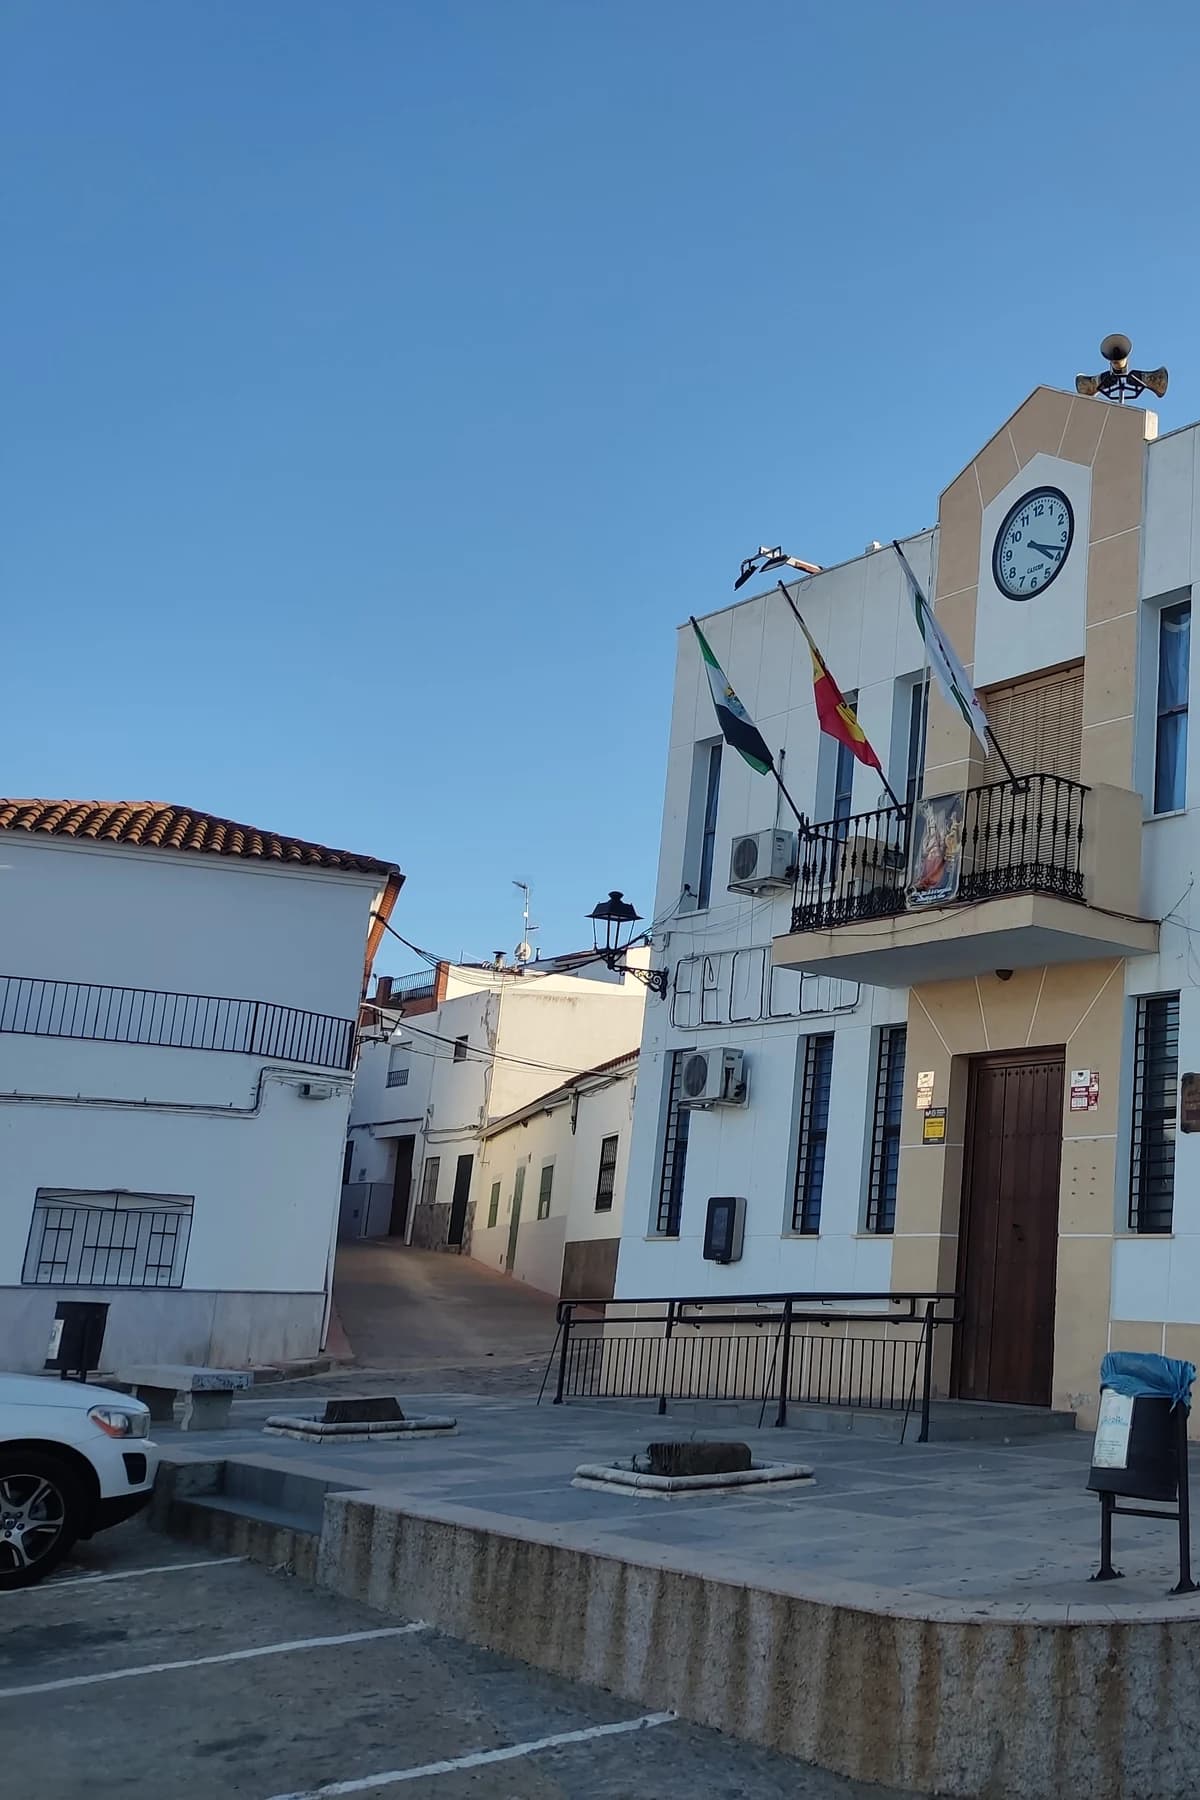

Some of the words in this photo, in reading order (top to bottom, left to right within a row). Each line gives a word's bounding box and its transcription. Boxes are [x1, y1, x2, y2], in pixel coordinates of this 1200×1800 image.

[1033, 504, 1044, 517] 12
[1048, 504, 1054, 516] 1
[1021, 515, 1030, 527] 11
[1058, 513, 1065, 526] 2
[1010, 531, 1022, 544] 10
[1060, 531, 1067, 543] 3
[1005, 550, 1013, 562] 9
[1009, 567, 1016, 578] 8
[1044, 568, 1051, 579] 5
[1019, 576, 1026, 588] 7
[1030, 577, 1037, 588] 6
